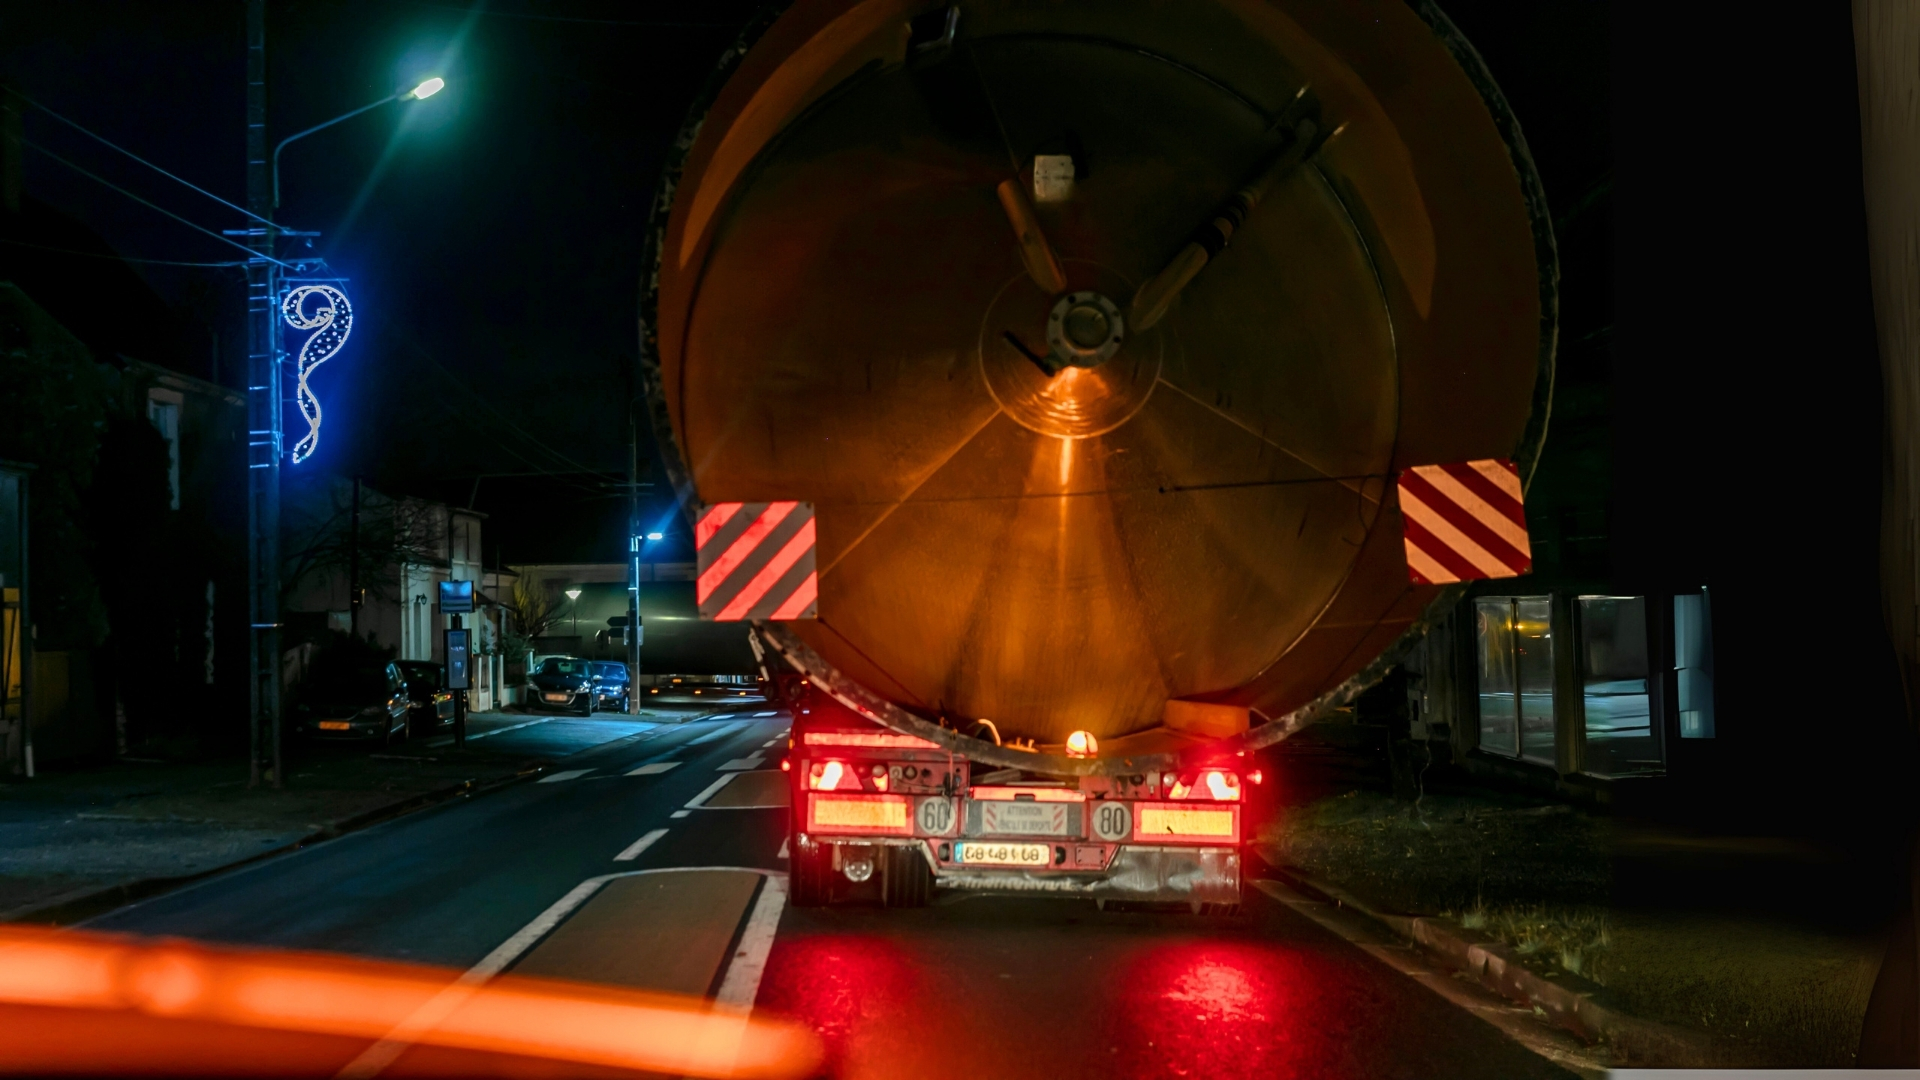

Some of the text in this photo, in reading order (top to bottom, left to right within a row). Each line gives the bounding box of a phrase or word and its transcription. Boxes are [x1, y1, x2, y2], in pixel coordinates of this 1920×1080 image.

[924, 802, 948, 830] 60
[1007, 805, 1043, 816] ATTENTION
[1100, 807, 1124, 835] 80
